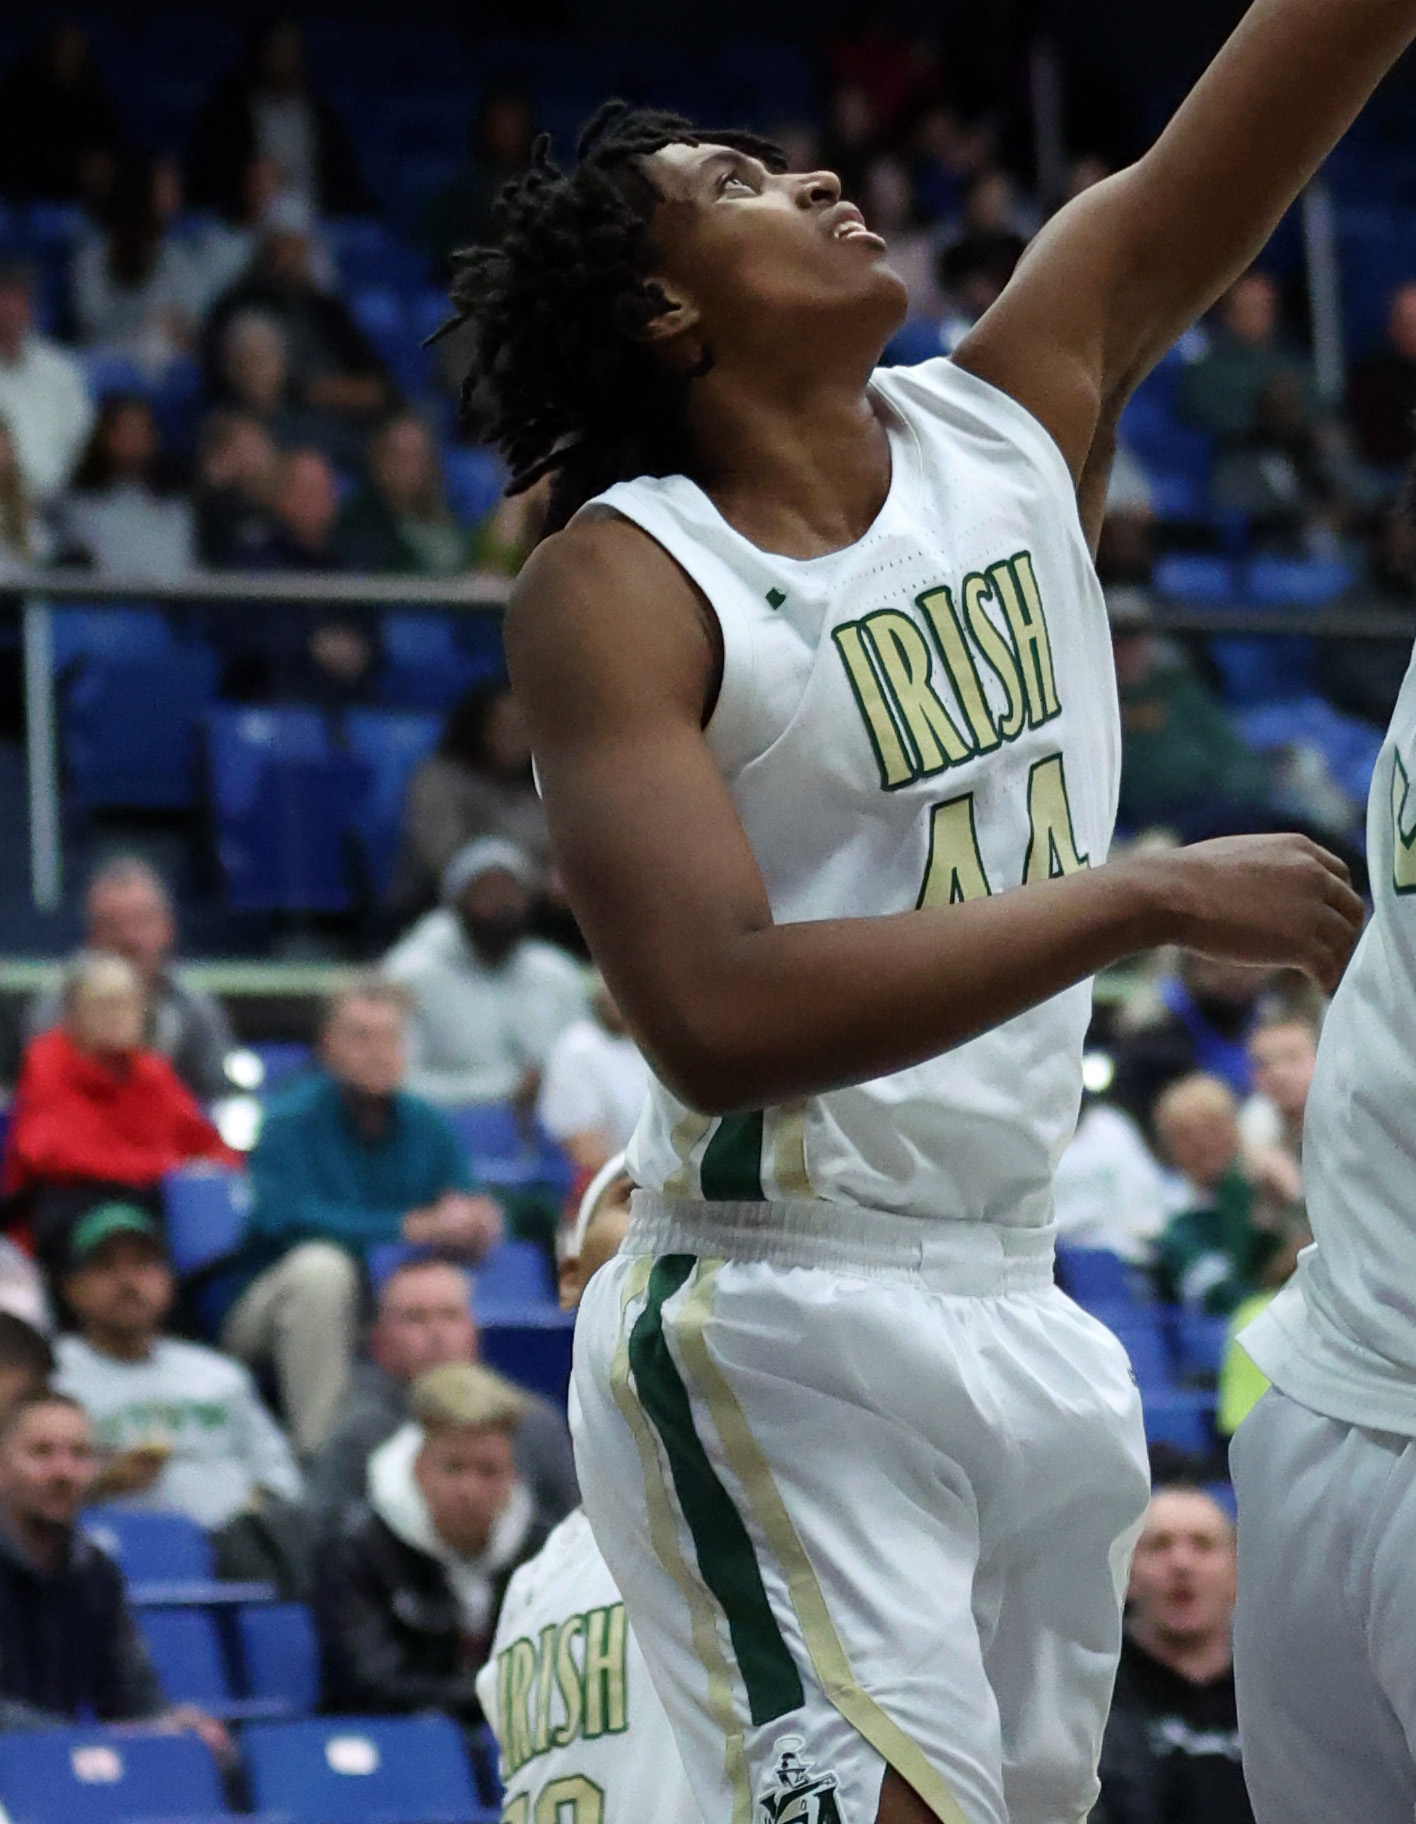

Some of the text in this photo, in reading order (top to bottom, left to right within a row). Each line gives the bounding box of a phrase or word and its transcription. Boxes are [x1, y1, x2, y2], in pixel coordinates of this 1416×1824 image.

[831, 550, 1062, 791] IRISH
[916, 753, 1091, 911] 44
[497, 1601, 628, 1782] IRISH
